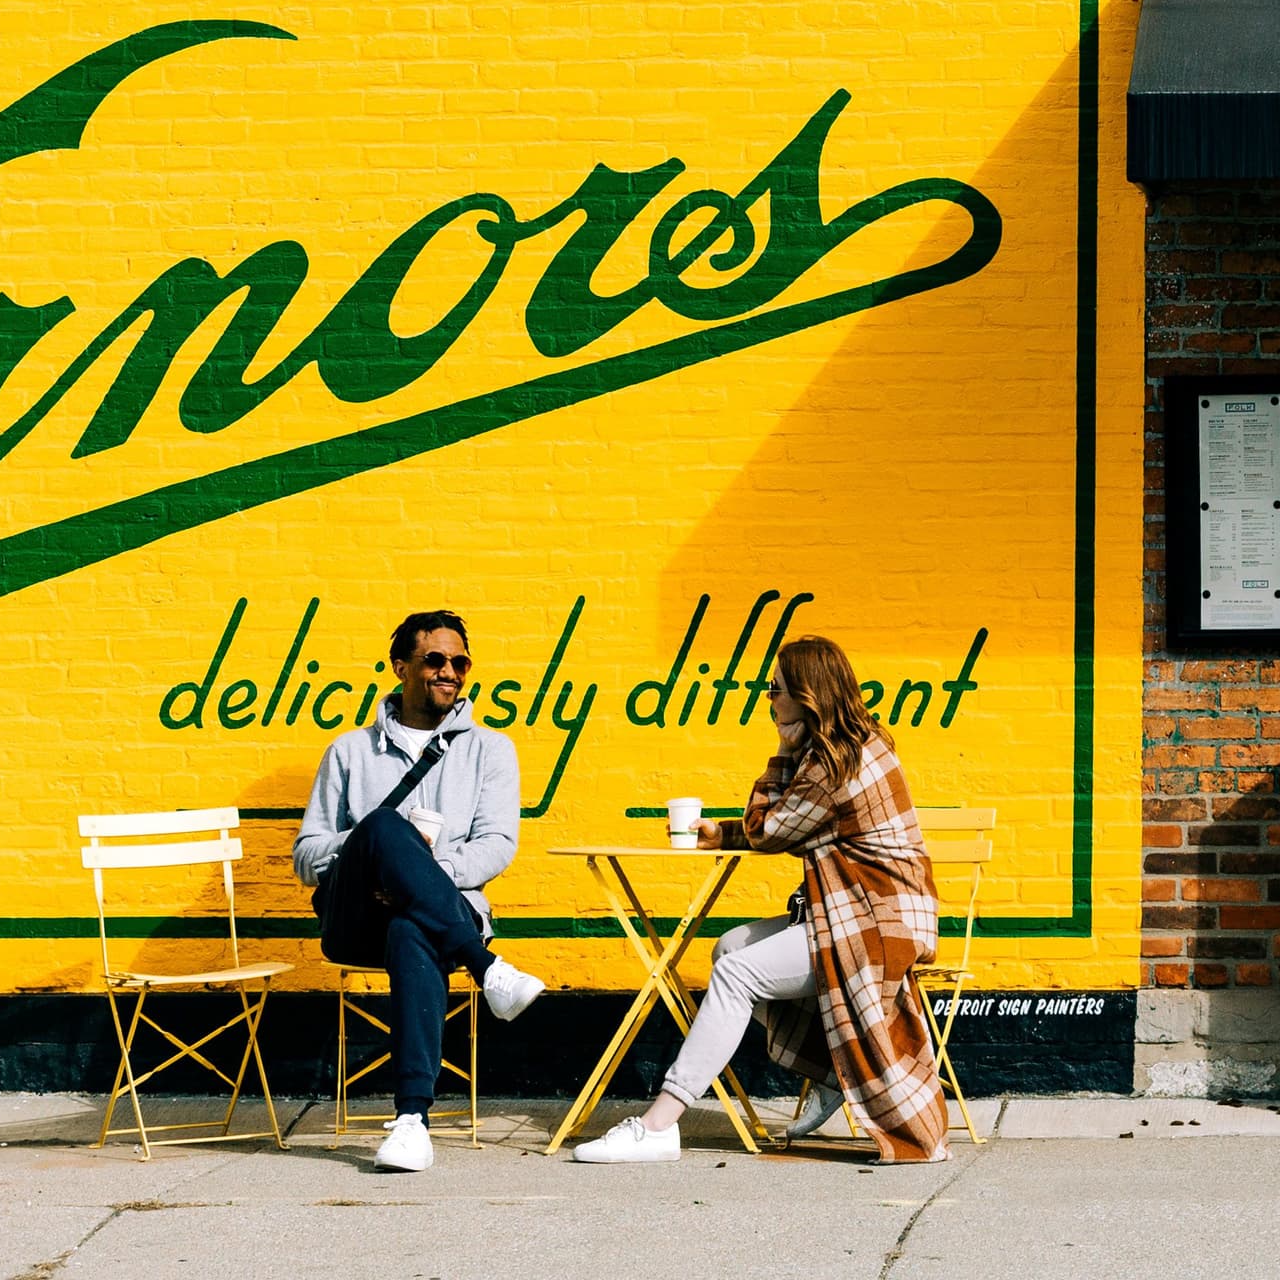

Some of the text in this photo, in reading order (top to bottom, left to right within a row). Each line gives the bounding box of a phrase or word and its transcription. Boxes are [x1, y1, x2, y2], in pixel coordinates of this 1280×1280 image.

[159, 589, 989, 818] delicisly diffent
[933, 998, 1105, 1016] DETROIT SIGN PAINTERS
